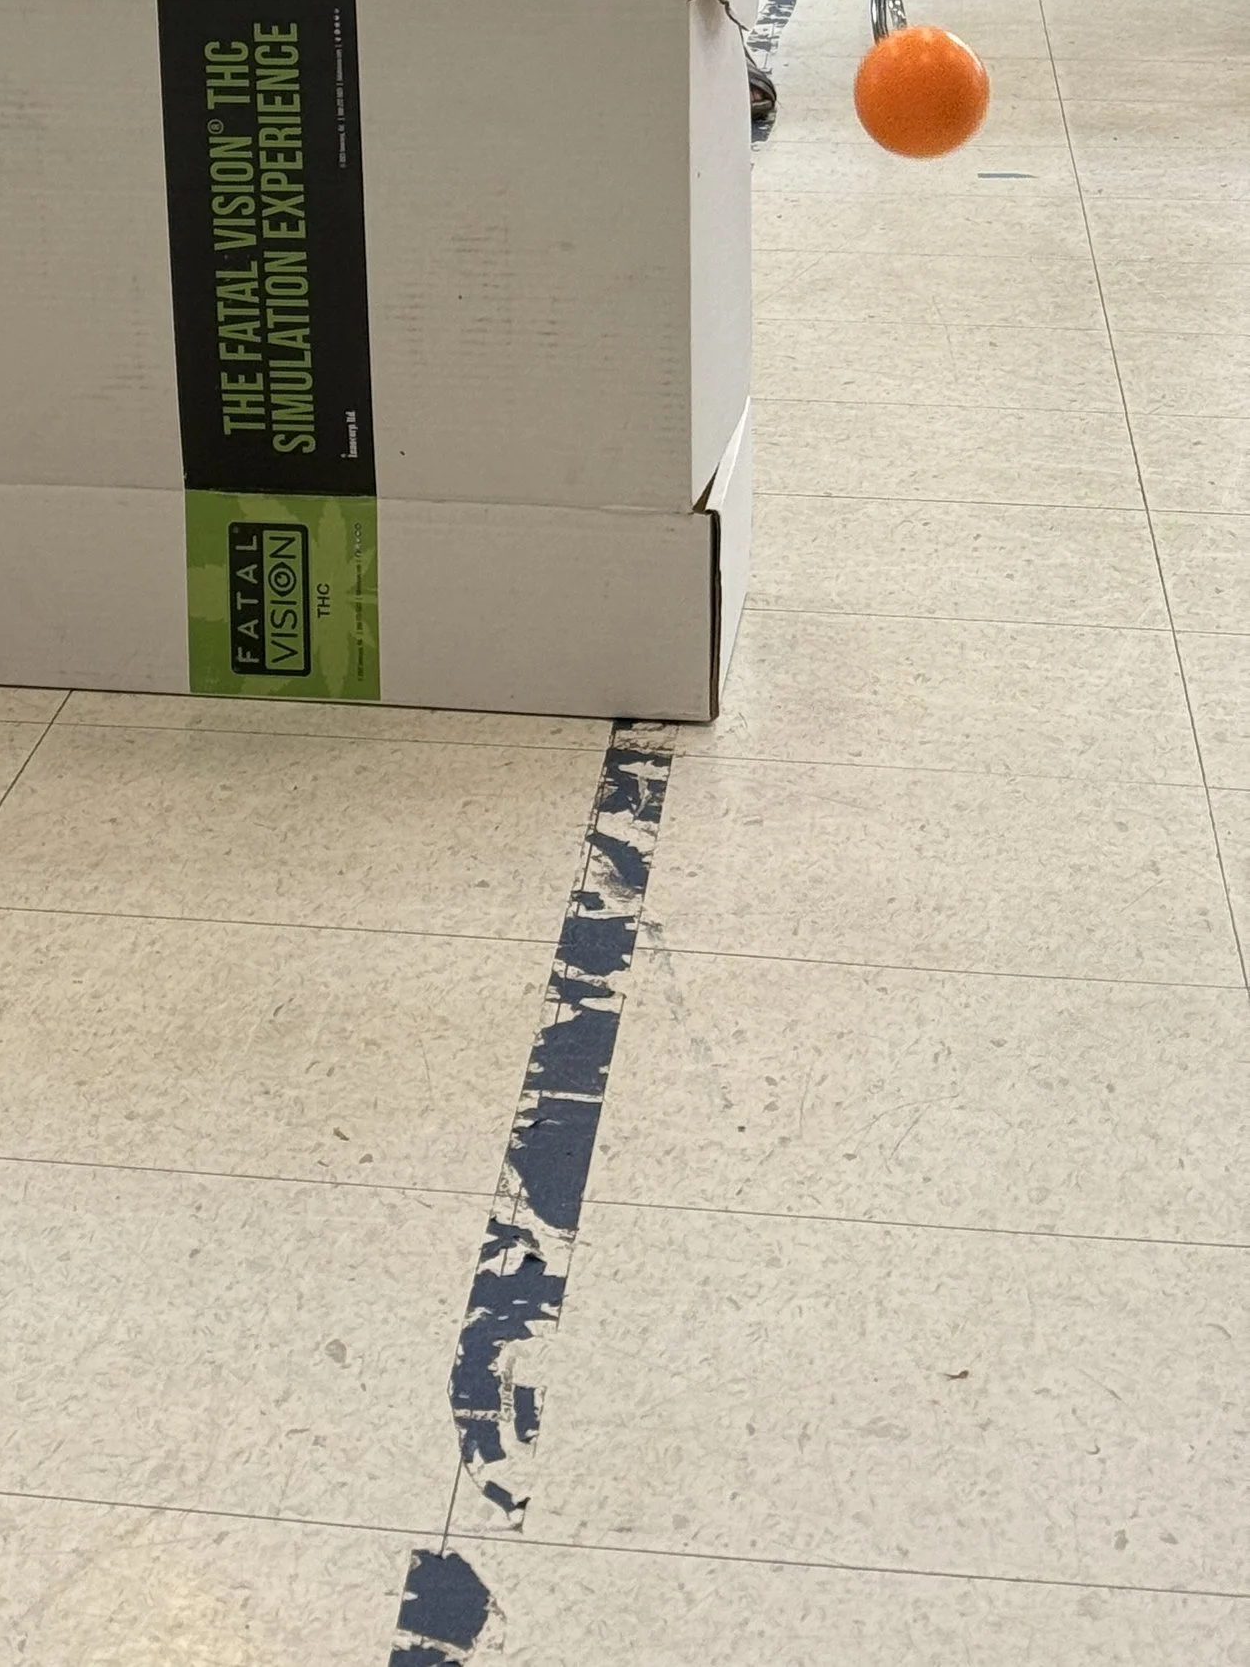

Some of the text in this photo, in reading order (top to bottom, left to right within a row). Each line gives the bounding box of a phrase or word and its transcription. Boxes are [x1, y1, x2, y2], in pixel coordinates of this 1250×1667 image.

[204, 40, 251, 110] THC
[253, 22, 316, 454] SIMULATION EXPERIENCE
[215, 260, 263, 361] FATAL
[220, 371, 267, 435] THE
[235, 535, 260, 663] FATAL
[268, 535, 299, 664] VISION
[317, 583, 331, 619] THC
